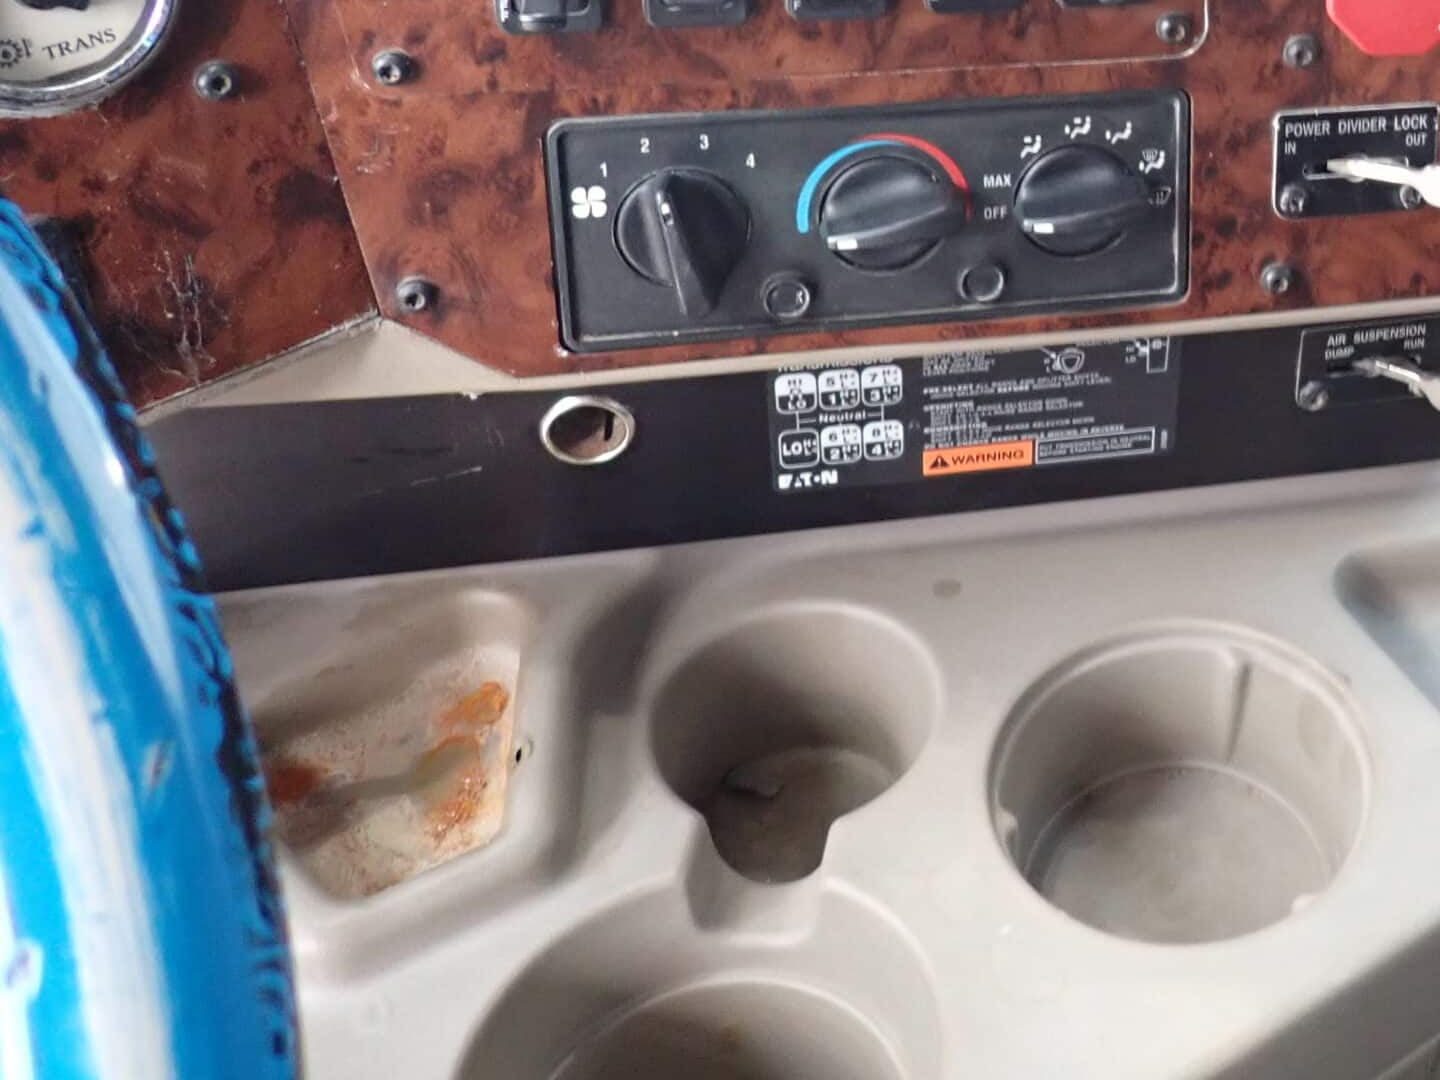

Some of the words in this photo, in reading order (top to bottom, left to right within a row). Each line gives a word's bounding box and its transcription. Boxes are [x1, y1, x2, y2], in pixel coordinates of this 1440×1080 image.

[42, 28, 117, 60] TRANS
[1285, 121, 1330, 138] POWER
[1338, 116, 1387, 135] DIVIDER
[1394, 113, 1428, 132] LOCK
[640, 138, 650, 154] 2
[699, 134, 710, 151] 3
[1405, 133, 1428, 147] OUT
[1285, 141, 1297, 155] IN
[745, 153, 755, 169] 4
[600, 163, 608, 177] 1
[983, 175, 1013, 189] MAX
[983, 206, 1008, 221] OFF
[1327, 333, 1347, 347] AIR
[1354, 322, 1427, 345] SUSPENSION
[1404, 336, 1426, 351] RUN
[1325, 346, 1355, 361] DUMP
[829, 393, 836, 406] 1
[819, 409, 867, 424] Neutral
[782, 440, 803, 457] LO
[871, 443, 882, 456] 4
[951, 449, 1024, 466] WARNING
